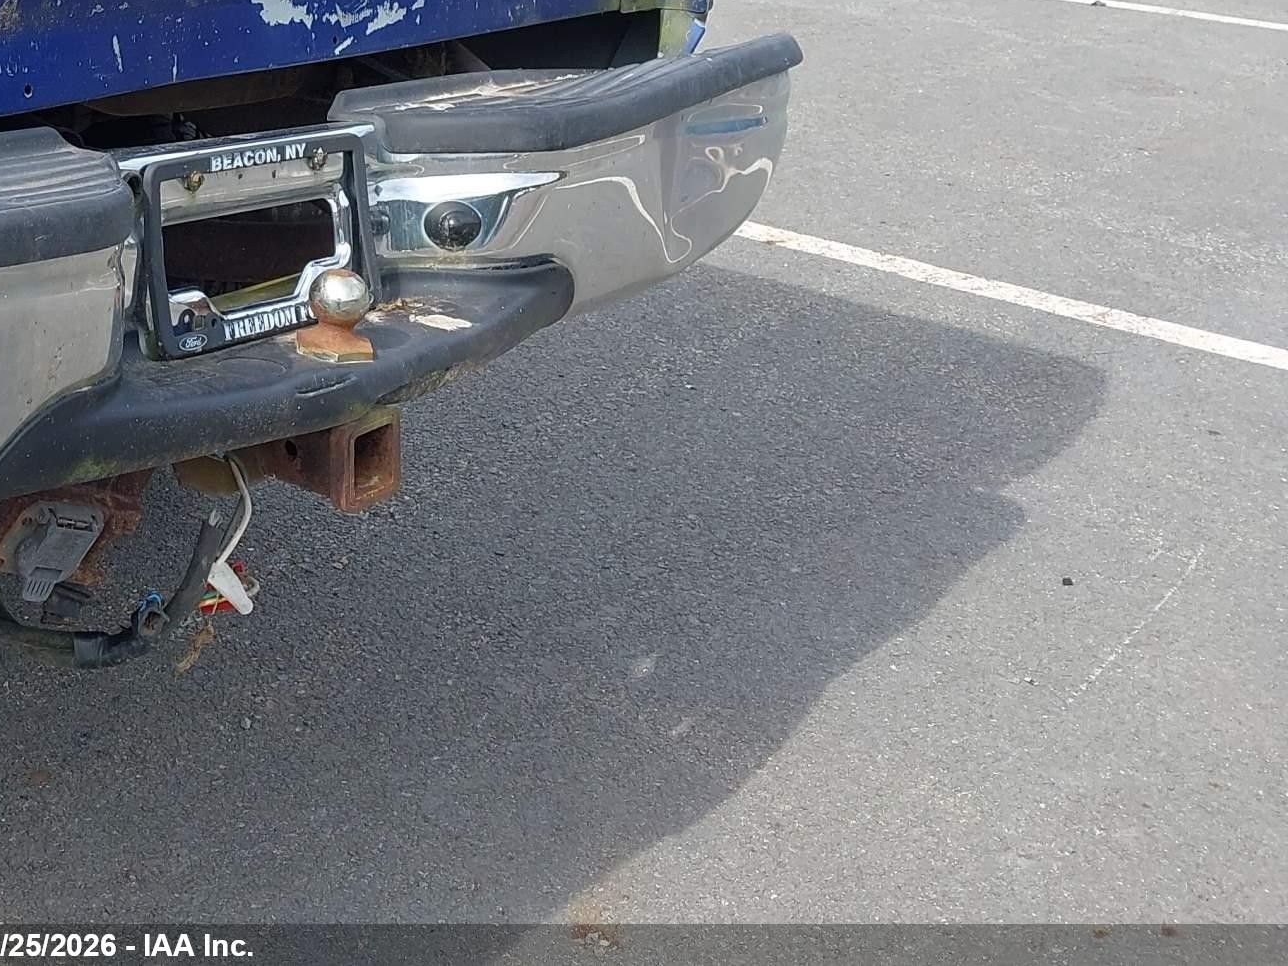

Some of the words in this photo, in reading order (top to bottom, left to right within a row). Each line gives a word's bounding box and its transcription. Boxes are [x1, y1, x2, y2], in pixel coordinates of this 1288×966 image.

[211, 147, 281, 172] BEACON,
[285, 142, 307, 160] NY
[223, 306, 298, 341] FREEDOM
[185, 336, 202, 349] Ford
